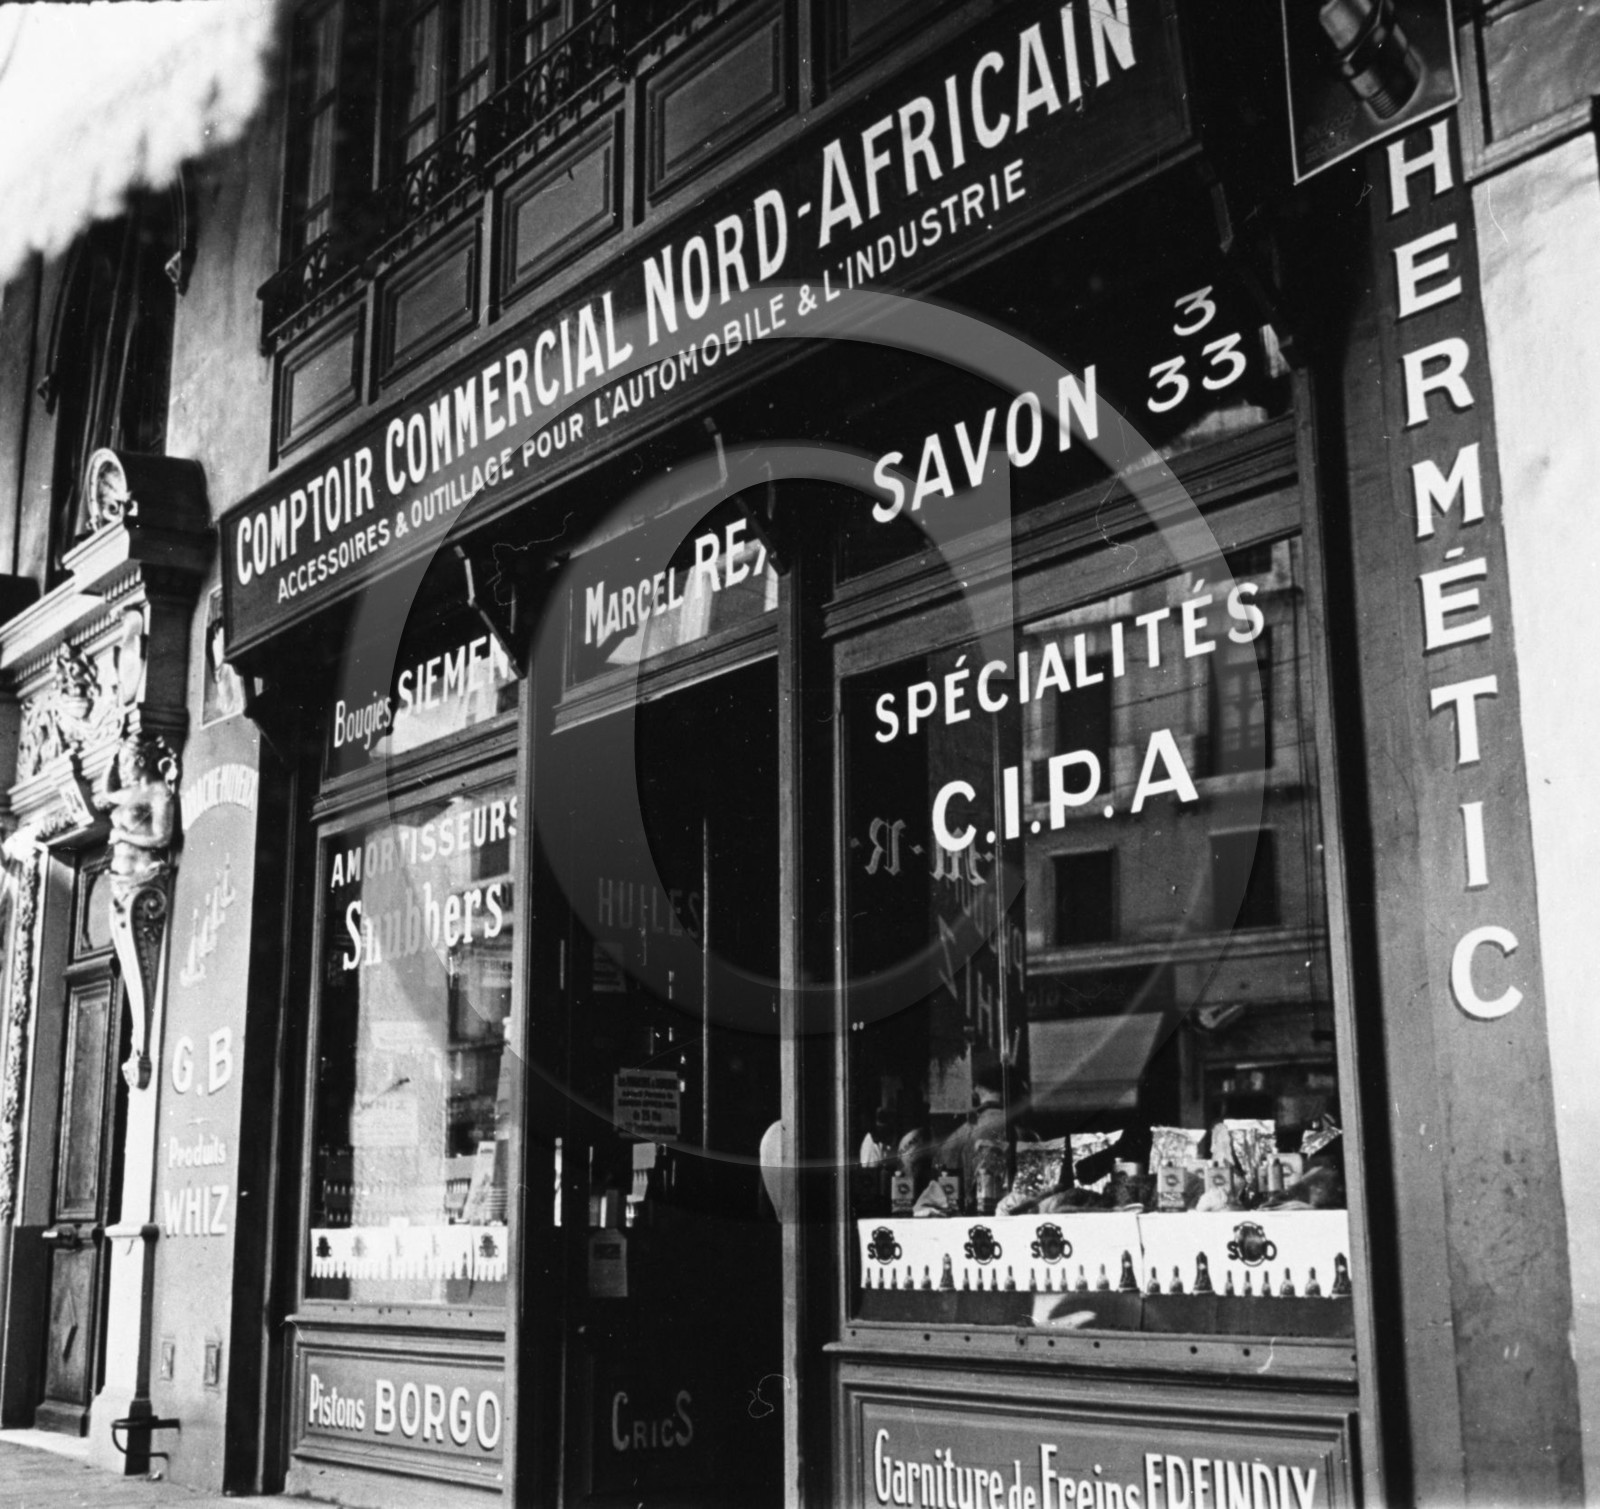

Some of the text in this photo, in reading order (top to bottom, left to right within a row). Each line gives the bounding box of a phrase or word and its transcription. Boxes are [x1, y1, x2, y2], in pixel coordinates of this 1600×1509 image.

[236, 0, 1137, 585] COMPTOIR COMMERCIAL NORD-AFRICAIN
[1173, 286, 1217, 337] 3
[277, 158, 1027, 604] ACCESSOIRES & OUTILLAGE POUR L'AUTOMOBILE & L'INDUSTRIE
[872, 364, 1099, 523] SAVON
[585, 566, 684, 648] MARCEL
[1387, 118, 1524, 1020] HERMÉTIC
[875, 579, 1265, 743] SPÉCIALITÉS
[334, 691, 391, 750] Bougies
[598, 877, 702, 939] HUILES
[164, 1185, 229, 1236] WHIZ
[309, 1373, 365, 1430] Pistons
[375, 1379, 501, 1449] BORGO
[875, 1428, 1004, 1509] Garniture
[1008, 1459, 1036, 1509] de
[1040, 1443, 1141, 1509] Freins
